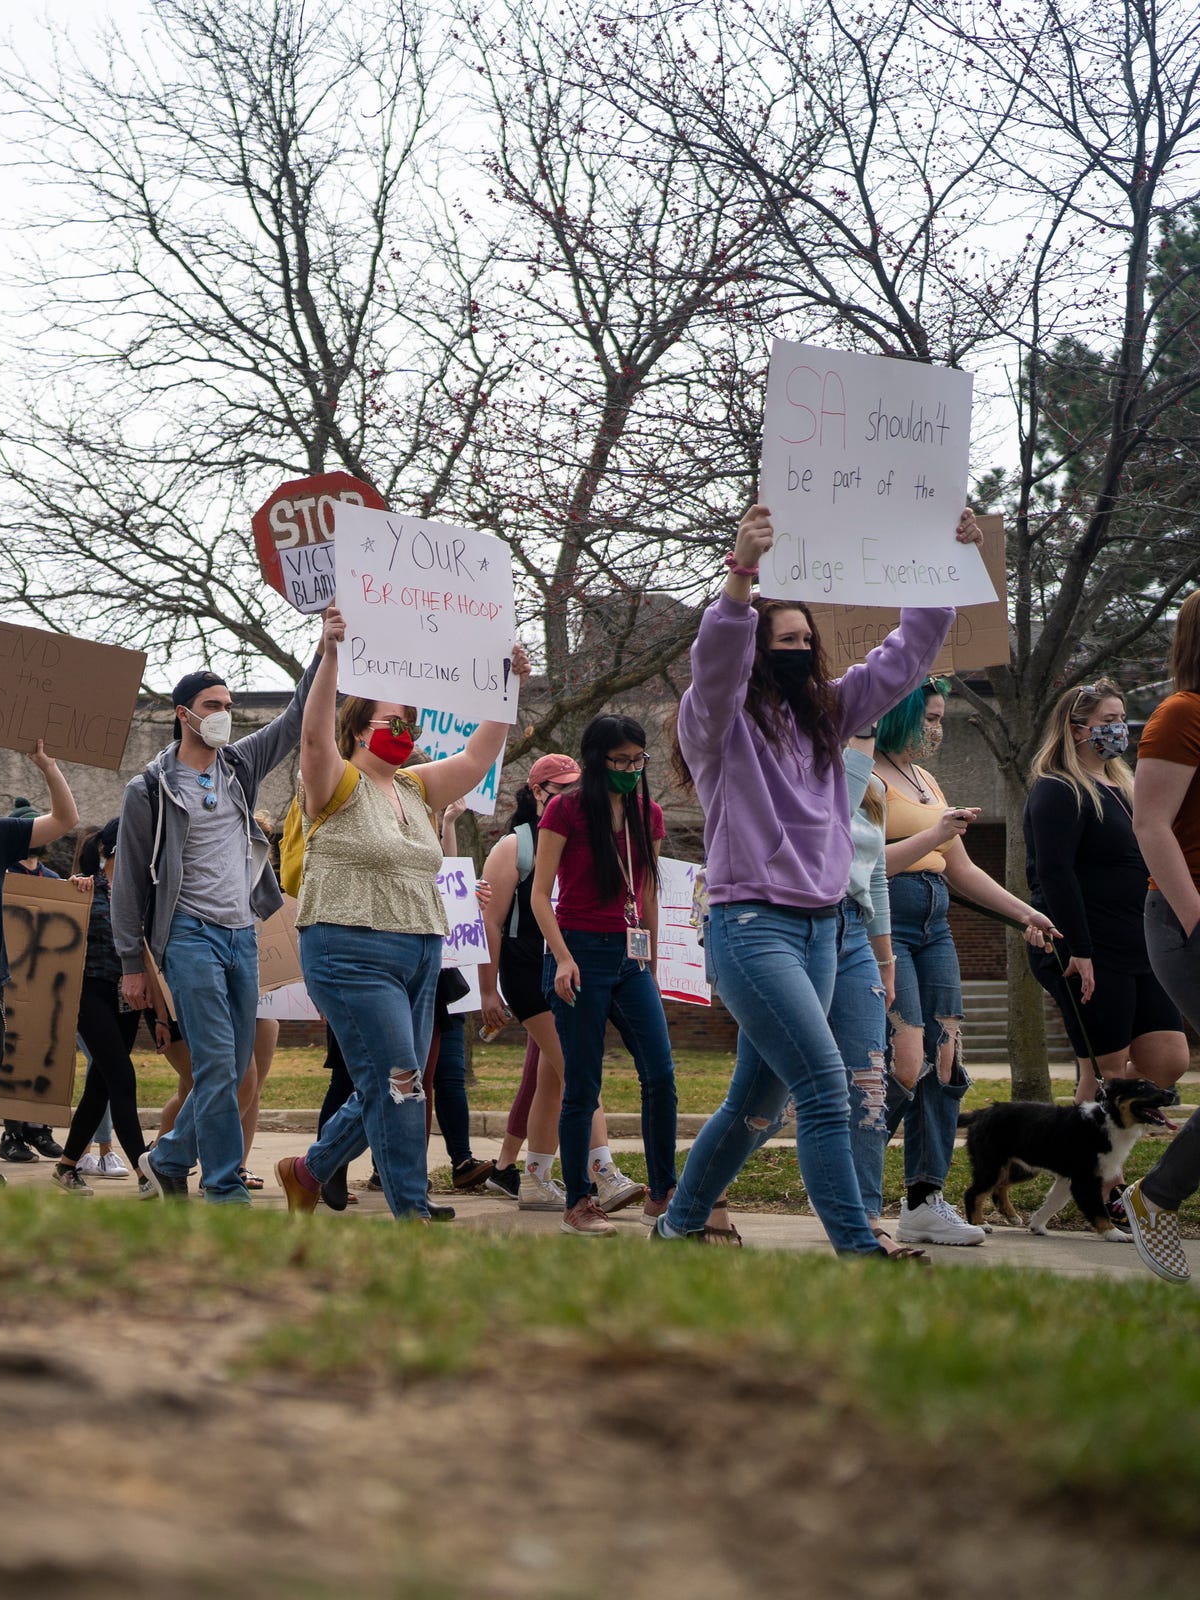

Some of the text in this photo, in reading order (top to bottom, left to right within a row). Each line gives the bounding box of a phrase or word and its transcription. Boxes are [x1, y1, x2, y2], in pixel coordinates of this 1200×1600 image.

[777, 364, 951, 451] SA shouldn't
[787, 455, 936, 504] be part of the
[386, 520, 476, 582] YOUR
[771, 532, 961, 594] College Experience
[419, 614, 439, 633] IS
[16, 667, 55, 694] the
[421, 706, 454, 735] MU
